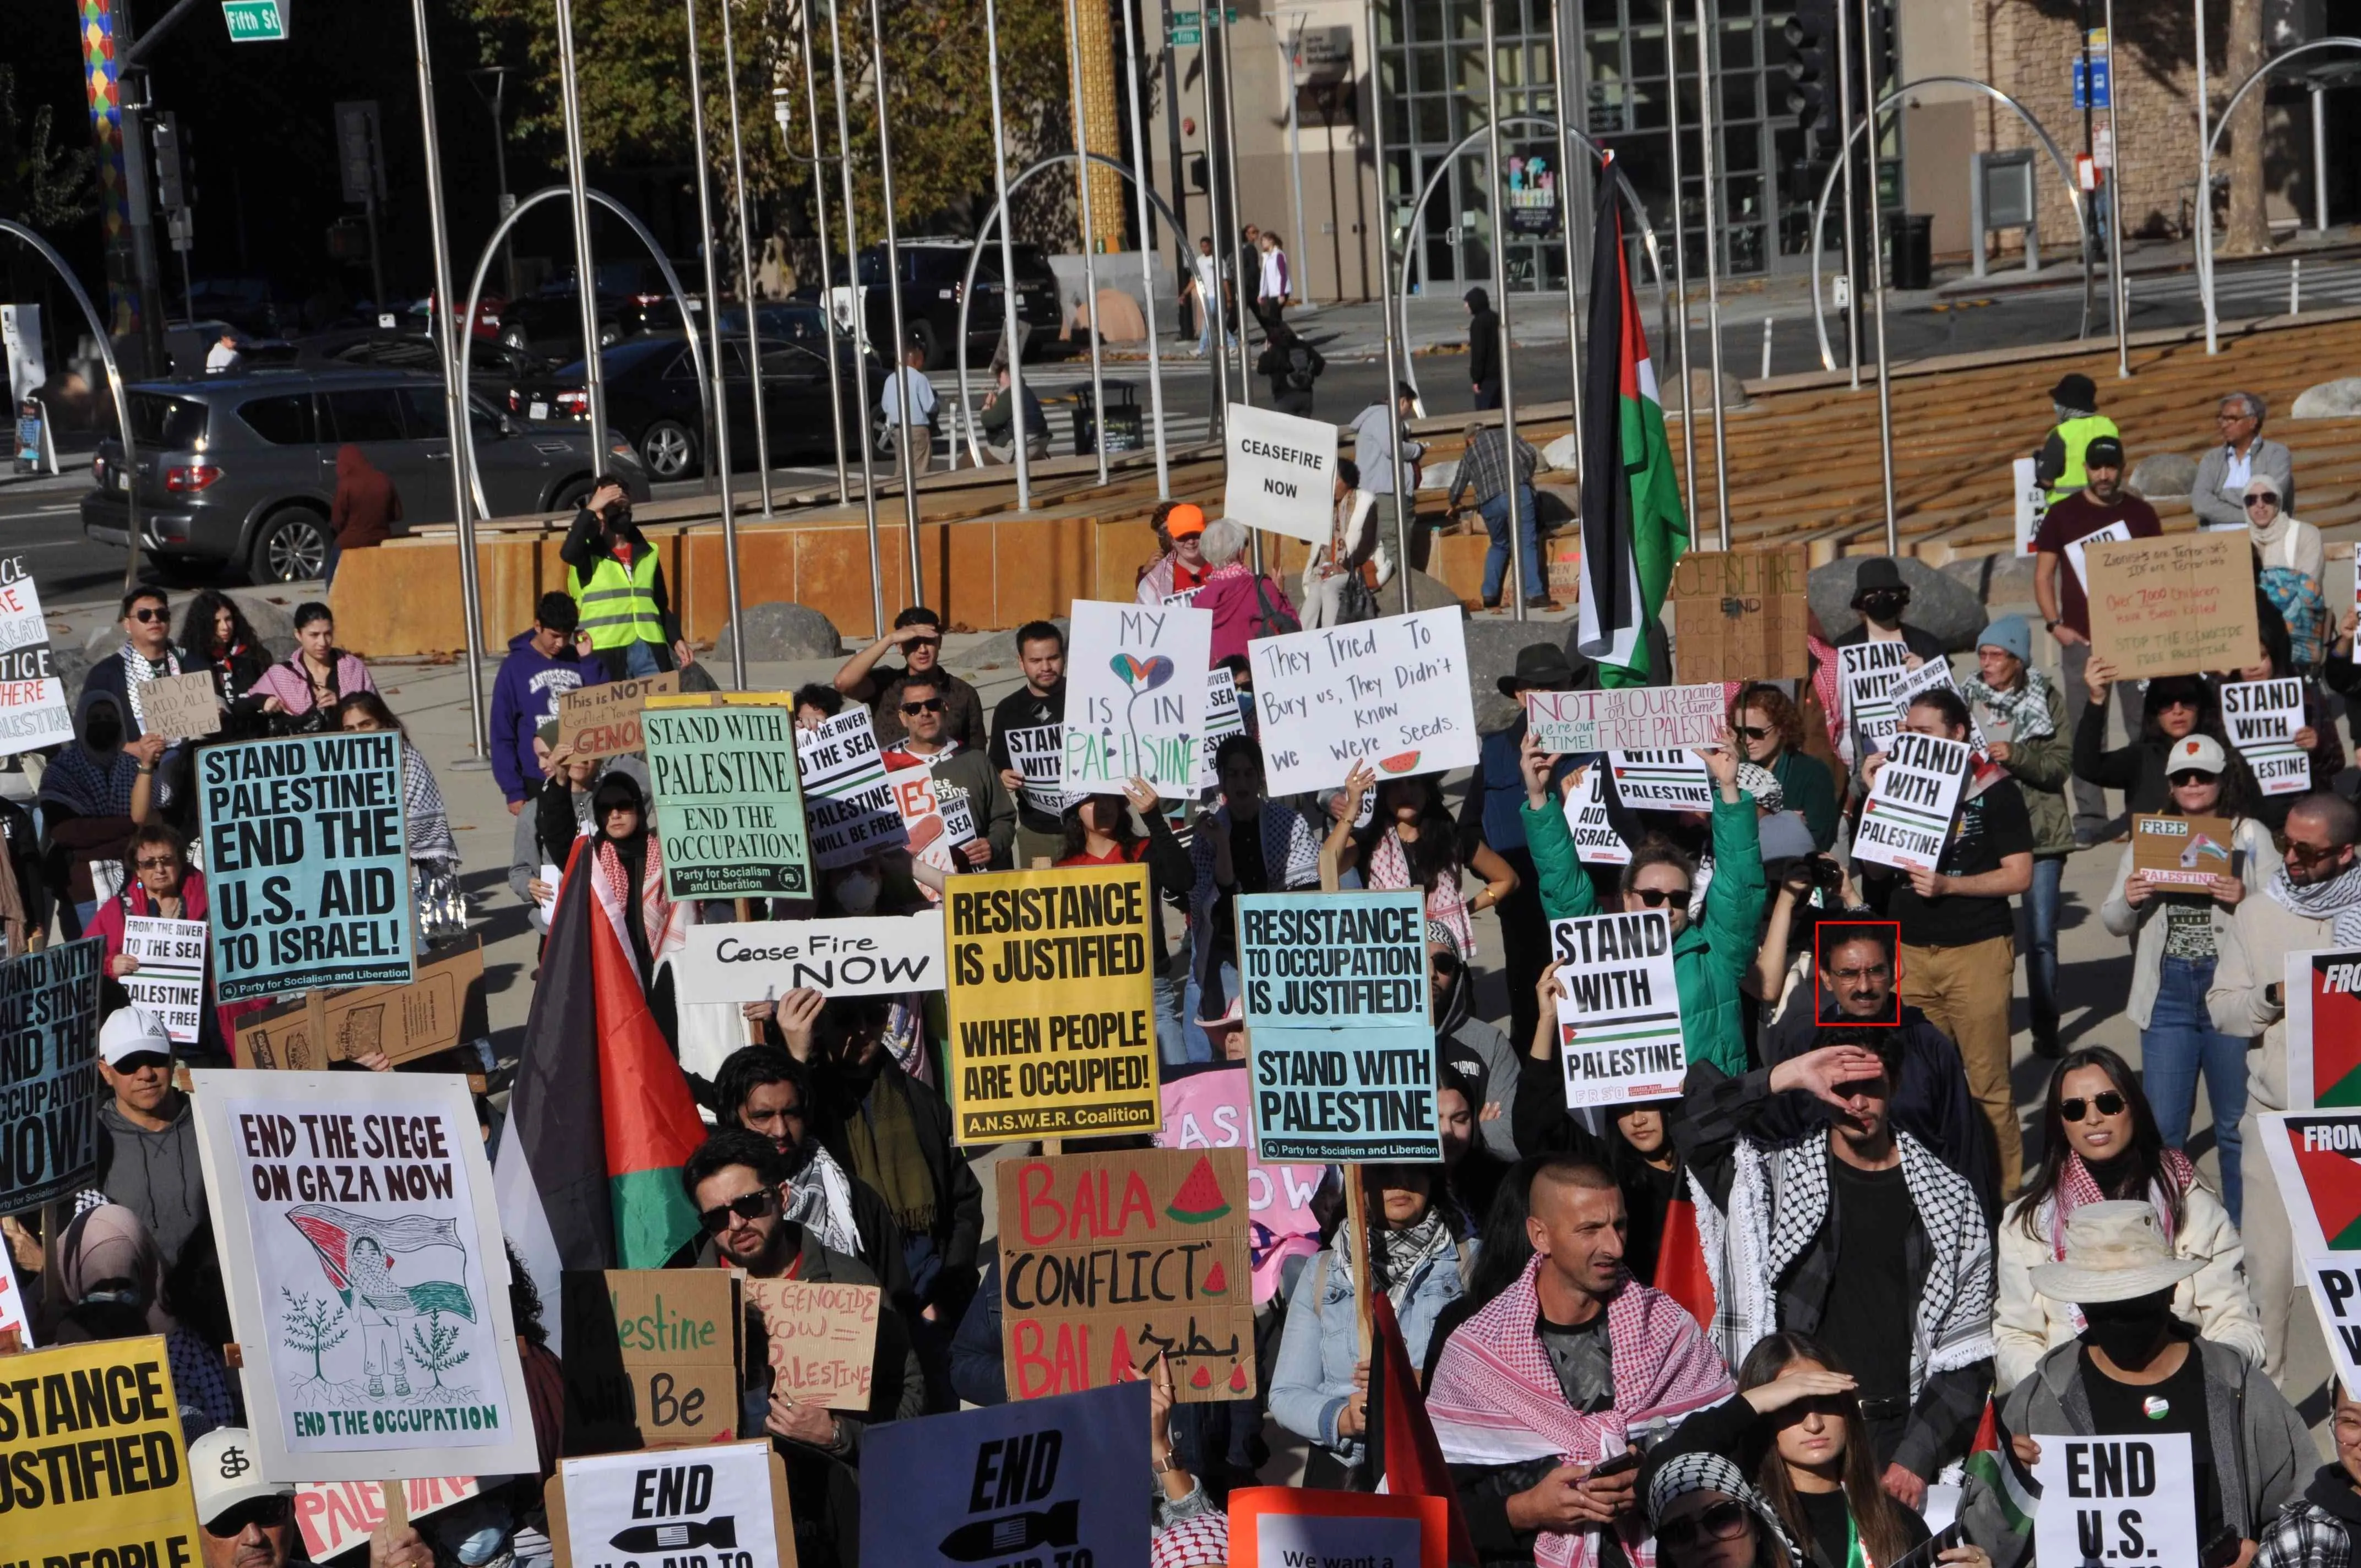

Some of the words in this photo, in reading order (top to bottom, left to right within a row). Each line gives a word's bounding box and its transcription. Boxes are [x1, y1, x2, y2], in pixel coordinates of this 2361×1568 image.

[227, 10, 259, 31] Fifth
[261, 9, 278, 29] St
[1241, 439, 1323, 470] CEASEFIRE
[1264, 478, 1297, 498] NOW
[1720, 598, 1761, 613] END
[1120, 610, 1166, 648] MY
[2154, 631, 2180, 646] THE
[1260, 644, 1310, 678] They
[1323, 629, 1377, 668] Tried
[1402, 619, 1431, 650] To
[175, 674, 209, 692] YOU
[561, 692, 592, 710] This
[596, 692, 607, 705] is
[611, 679, 654, 702] NOT
[1210, 688, 1236, 707] SEA
[1261, 691, 1307, 725] Bury
[1316, 688, 1343, 705] us,
[1346, 674, 1383, 701] They
[1395, 657, 1452, 689] Didn't
[1890, 680, 1908, 700] FROM
[1908, 673, 1924, 689] THE
[2225, 682, 2299, 713] STAND
[183, 694, 210, 707] ALL
[1089, 696, 1113, 724] IS
[1154, 694, 1184, 725] IN
[1527, 692, 1602, 723] NOT
[1629, 689, 1678, 718] OUR
[1682, 685, 1721, 701] name
[145, 711, 188, 731] LIVES
[162, 718, 220, 738] MATTER
[648, 716, 720, 746] STAND
[726, 715, 784, 743] WITH
[836, 712, 867, 735] RIVER
[1575, 721, 1596, 731] out
[1598, 717, 1649, 749] FREE
[2235, 717, 2288, 741] WITH
[810, 744, 842, 771] THE
[846, 731, 877, 759] SEA
[1548, 733, 1594, 750] TIME!
[1886, 734, 1966, 776] STAND
[205, 743, 307, 785] STAND
[313, 736, 394, 772] WITH
[654, 751, 791, 796] PALESTINE
[1066, 732, 1200, 786] PALESTINE
[209, 771, 396, 822] PALESTINE!
[1619, 784, 1711, 802] PALESTINE
[1884, 770, 1943, 808] WITH
[684, 806, 728, 831] END
[732, 806, 777, 829] THE
[808, 783, 895, 832] PALESTINE
[941, 799, 965, 816] RIVER
[1579, 806, 1605, 825] AID
[211, 816, 304, 874] END
[315, 808, 401, 859] THE
[812, 831, 848, 854] WILL
[850, 824, 868, 843] BE
[871, 810, 904, 836] FREE
[947, 814, 972, 836] SEA
[1859, 820, 1941, 857] PALESTINE
[2141, 819, 2187, 835] FREE
[667, 833, 802, 862] OCCUPATION!
[676, 868, 705, 881] Party
[706, 868, 721, 879] for
[722, 866, 771, 878] Socialism
[690, 880, 710, 891] and
[711, 878, 762, 890] Liberation
[219, 876, 306, 930] U.S.
[319, 867, 395, 918] AID
[953, 881, 1143, 935] RESISTANCE
[127, 920, 155, 933] FROM
[157, 922, 173, 935] THE
[176, 924, 203, 938] RIVER
[1243, 907, 1420, 945] RESISTANCE
[1555, 913, 1667, 966] STAND
[51, 938, 100, 984] WITH
[126, 938, 142, 954] TO
[147, 939, 171, 957] THE
[176, 942, 202, 960] SEA
[219, 932, 259, 973] TO
[270, 919, 400, 966] ISRAEL!
[716, 938, 799, 963] Cease
[809, 935, 878, 956] Fire
[954, 943, 984, 986] IS
[993, 933, 1145, 983] JUSTIFIED
[1245, 949, 1270, 977] TO
[1275, 946, 1422, 977] OCCUPATION
[240, 982, 265, 994] Party
[266, 979, 283, 989] for
[284, 974, 332, 986] Socialism
[334, 971, 354, 981] and
[357, 968, 408, 980] Liberation
[793, 956, 930, 989] NOW
[1248, 981, 1272, 1014] IS
[1278, 979, 1422, 1015] JUSTIFIED!
[1571, 968, 1652, 1013] WITH
[170, 1010, 197, 1026] FREE
[960, 1017, 1041, 1058] WHEN
[1049, 1010, 1147, 1052] PEOPLE
[51, 1010, 97, 1072] THE
[964, 1064, 1013, 1101] ARE
[1019, 1054, 1150, 1097] OCCUPIED!
[1258, 1050, 1347, 1086] STAND
[1353, 1049, 1430, 1085] WITH
[1567, 1043, 1684, 1081] PALESTINE
[1575, 1085, 1624, 1103] FRSO
[969, 1113, 1070, 1133] A.N.S.W.E.R.
[1074, 1107, 1149, 1124] Coalition
[1260, 1091, 1434, 1133] PALESTINE
[239, 1114, 297, 1158] END
[299, 1114, 358, 1158] THE
[362, 1114, 449, 1159] SIEGE
[1282, 1145, 1304, 1156] Party
[1305, 1145, 1319, 1155] for
[1321, 1145, 1365, 1155] Socialism
[1368, 1145, 1386, 1155] and
[1390, 1144, 1438, 1155] Liberation
[252, 1164, 293, 1201] ON
[296, 1164, 381, 1202] GAZA
[387, 1163, 454, 1202] NOW
[1019, 1163, 1156, 1245] BALA
[781, 1284, 877, 1322] GENOCIDE
[650, 1373, 705, 1427] Be
[294, 1411, 325, 1437] END
[328, 1410, 369, 1435] THE
[373, 1404, 498, 1432] OCCUPATION
[969, 1429, 1062, 1514] END
[2065, 1442, 2156, 1498] END
[632, 1464, 713, 1520] END
[2077, 1509, 2158, 1559] U.S.
[1283, 1550, 1316, 1567] We
[1323, 1553, 1376, 1568] want
[1381, 1556, 1394, 1568] a
